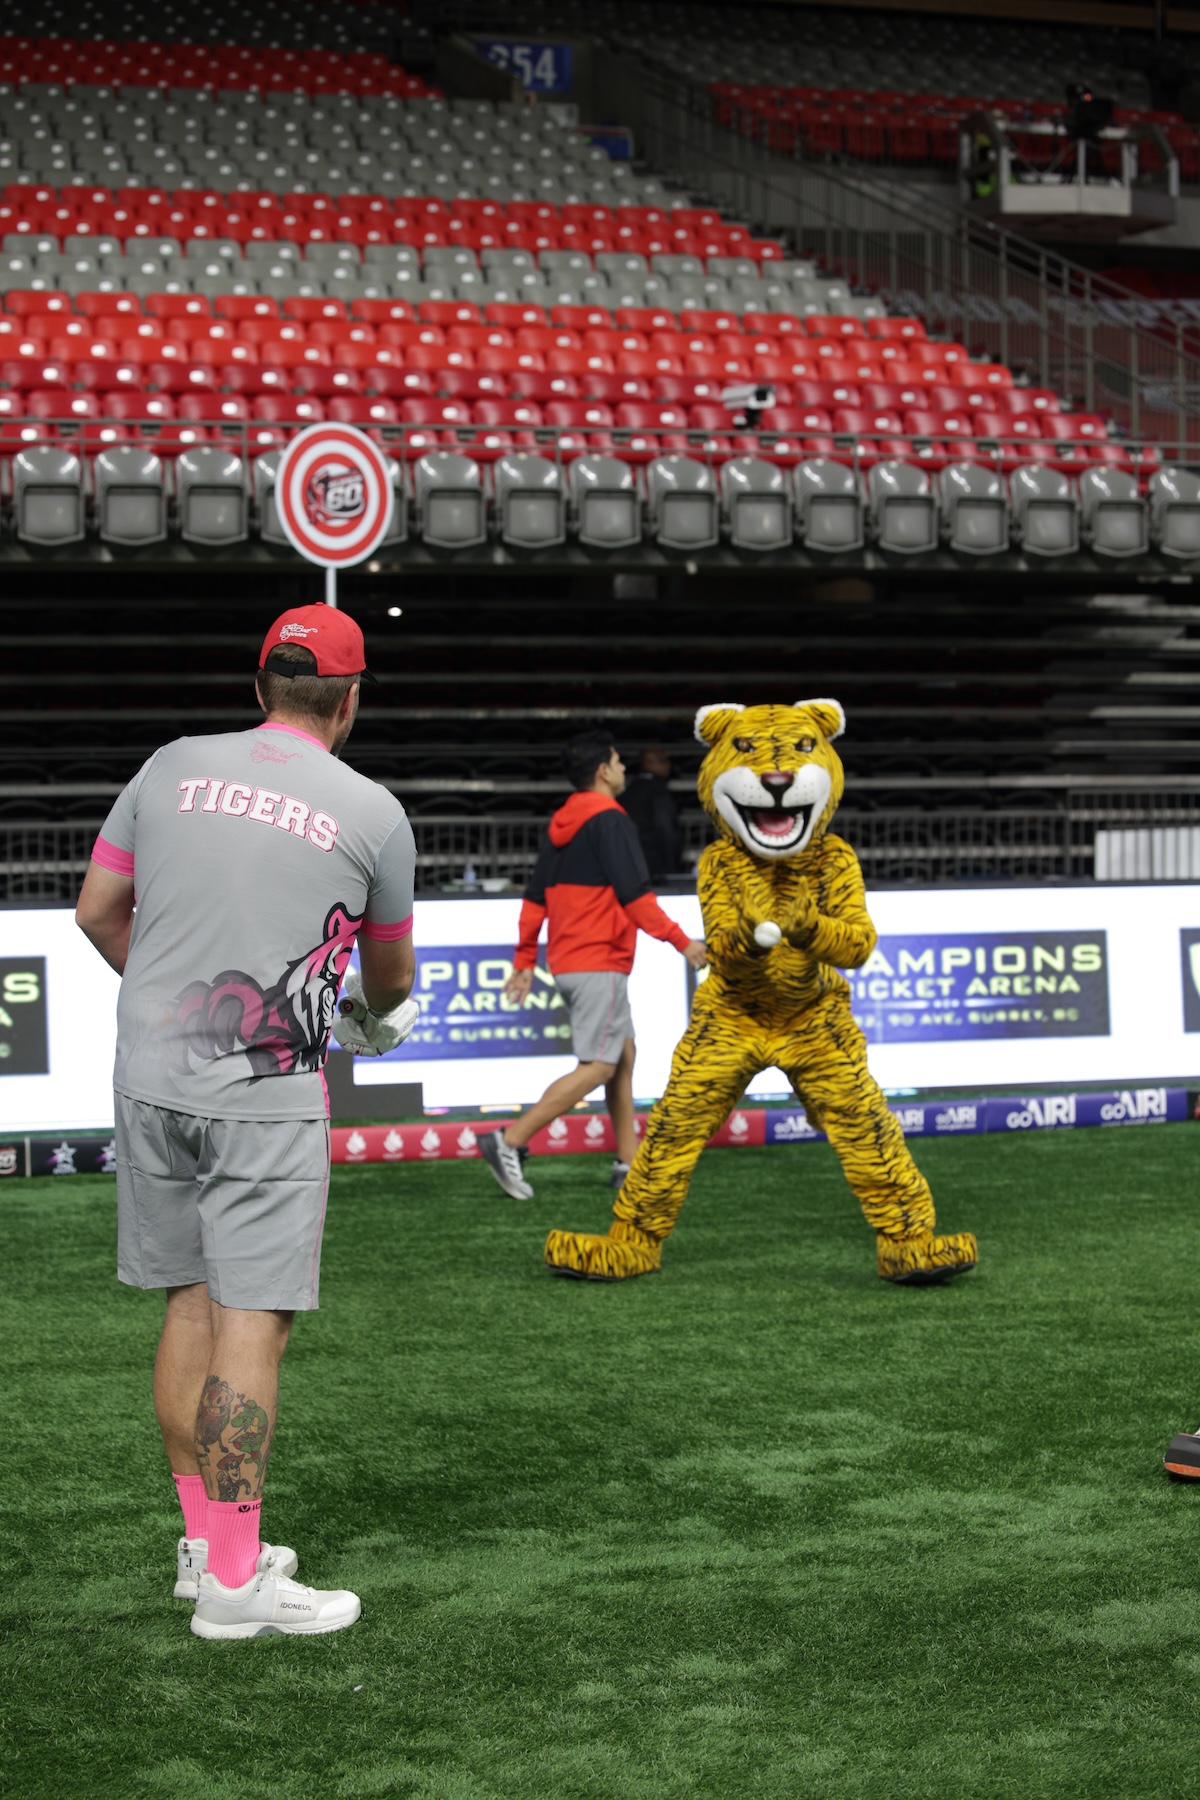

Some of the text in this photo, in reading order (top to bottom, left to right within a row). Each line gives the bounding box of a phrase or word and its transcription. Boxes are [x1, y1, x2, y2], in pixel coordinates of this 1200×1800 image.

[178, 777, 339, 853] TIGERS
[847, 944, 1102, 978] AMPIONS
[850, 973, 1081, 1000] ICKET ARENA
[280, 1602, 312, 1611] IDONEUS
